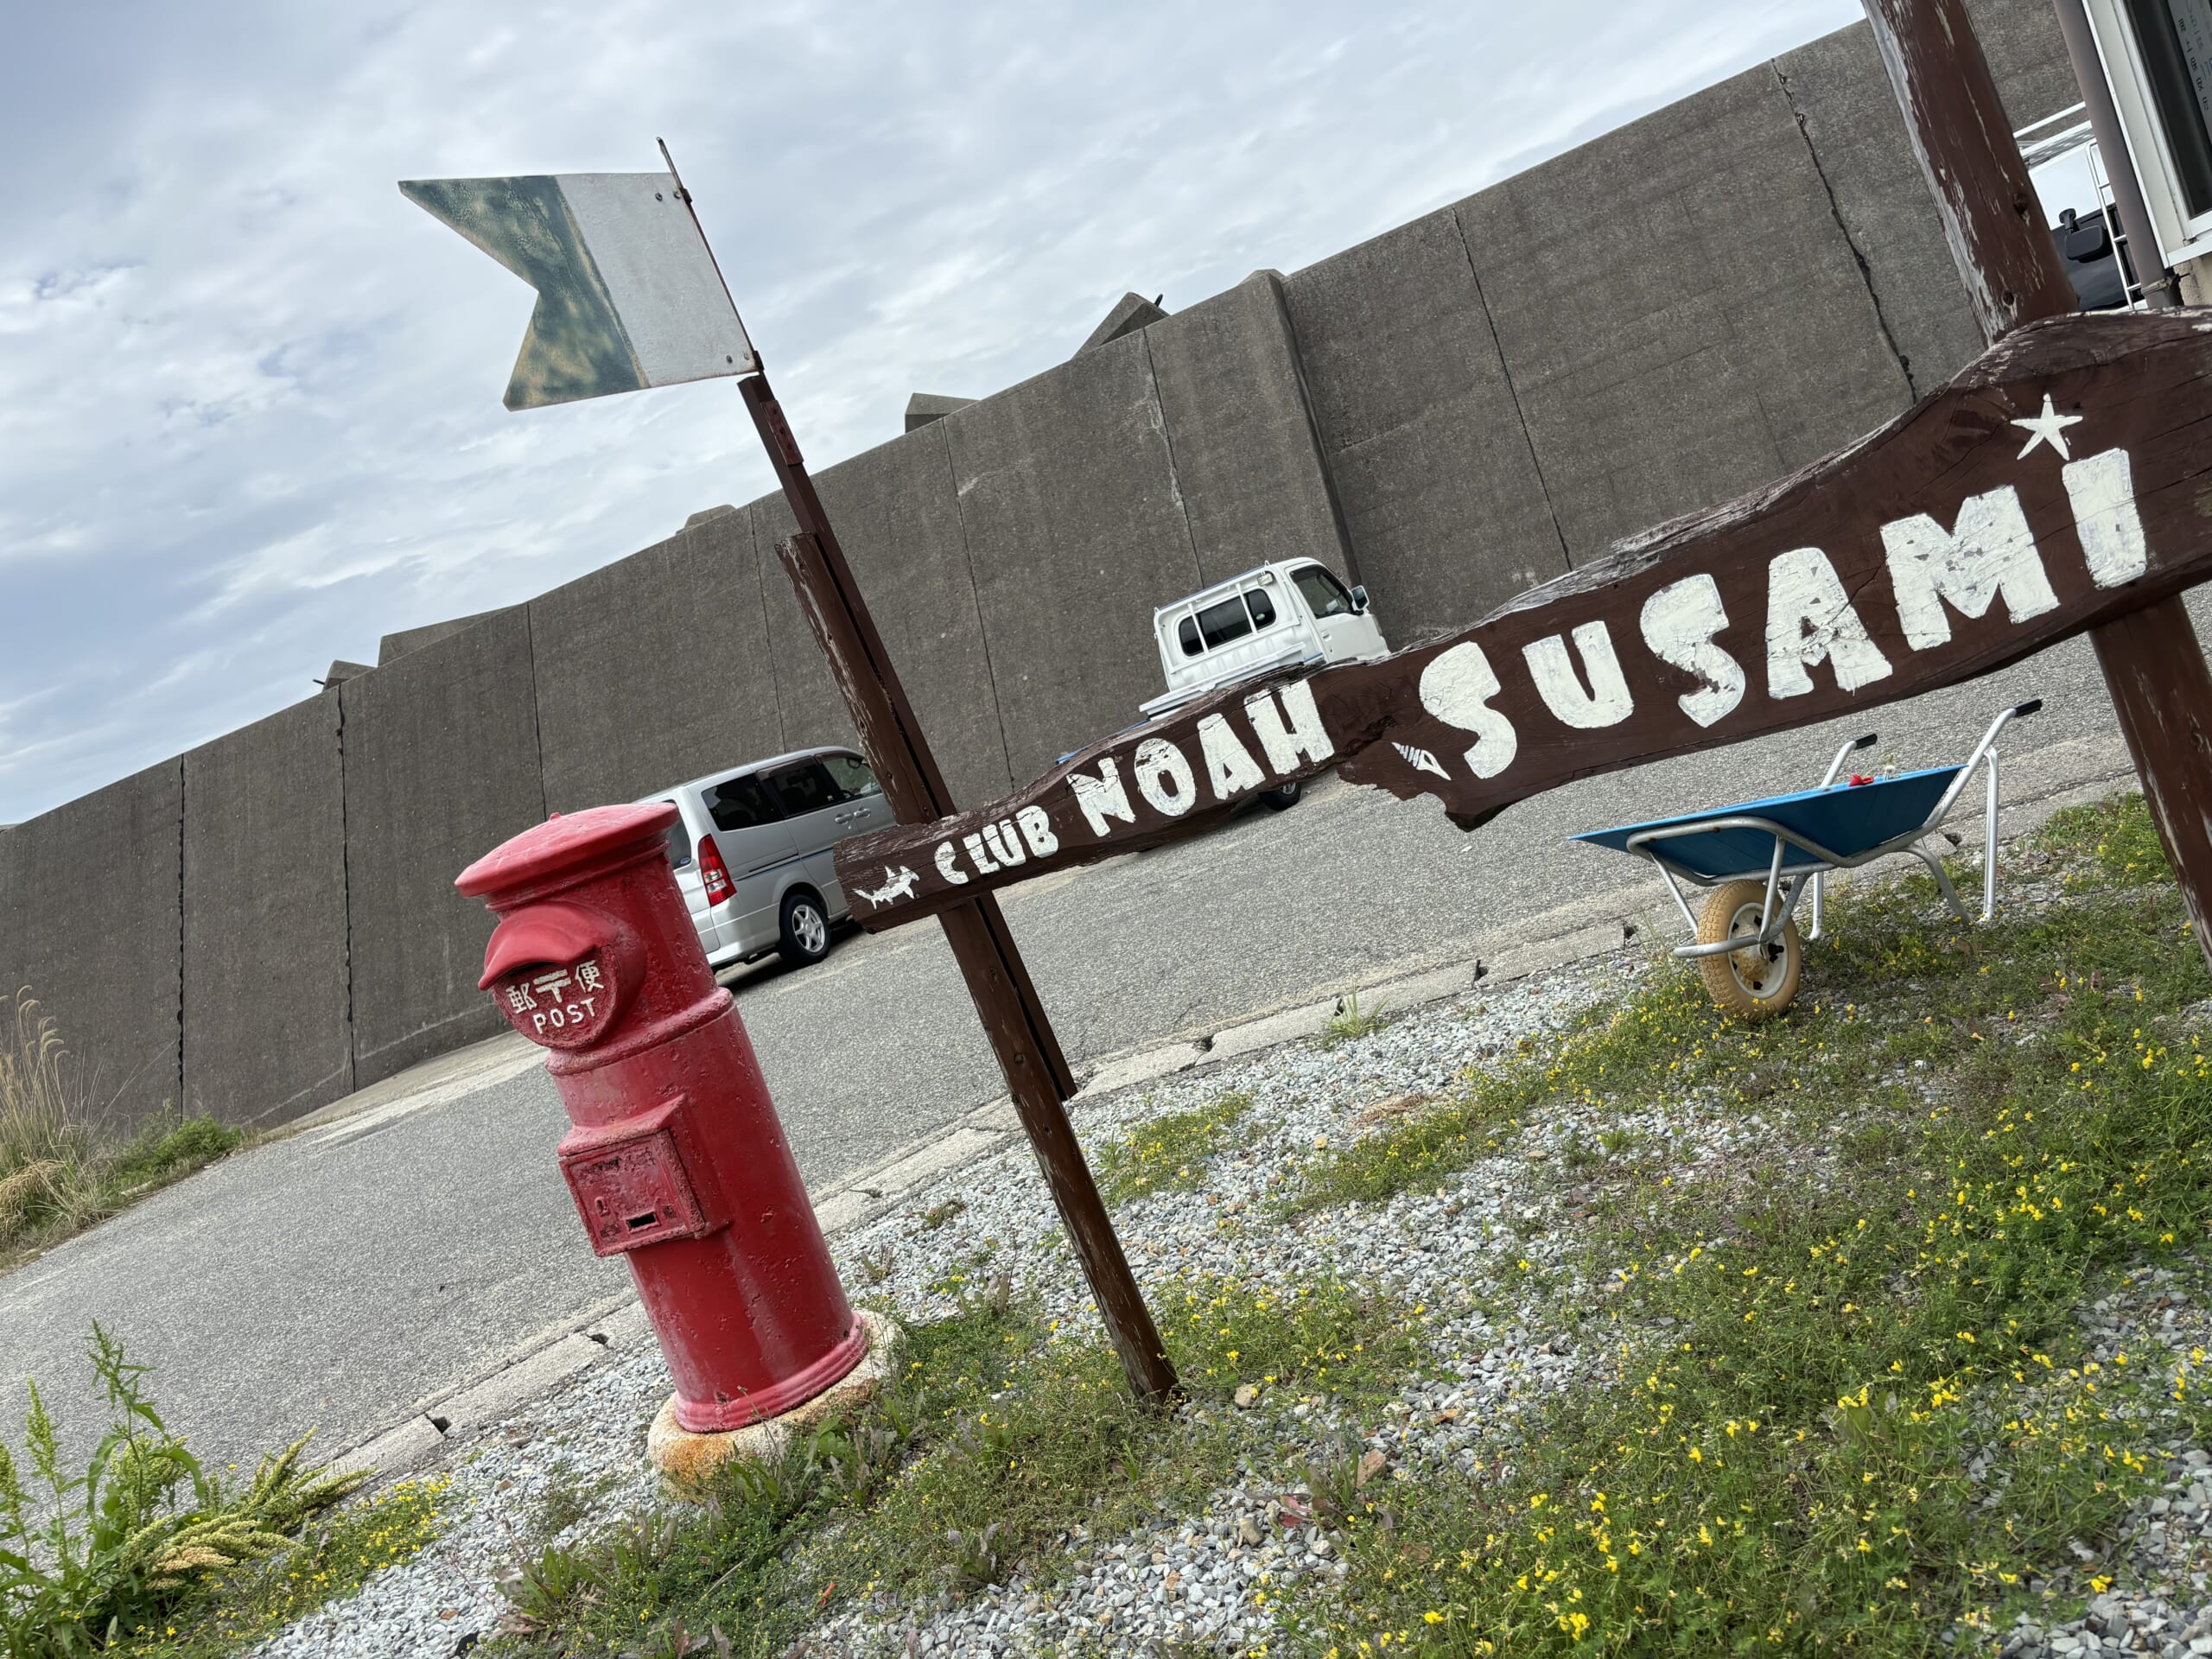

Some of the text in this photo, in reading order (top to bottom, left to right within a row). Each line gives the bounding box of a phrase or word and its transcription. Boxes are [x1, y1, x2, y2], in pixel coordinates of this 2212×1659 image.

[933, 447, 2148, 886] CLUB NOAH SUSAMI
[532, 996, 595, 1035] POST
